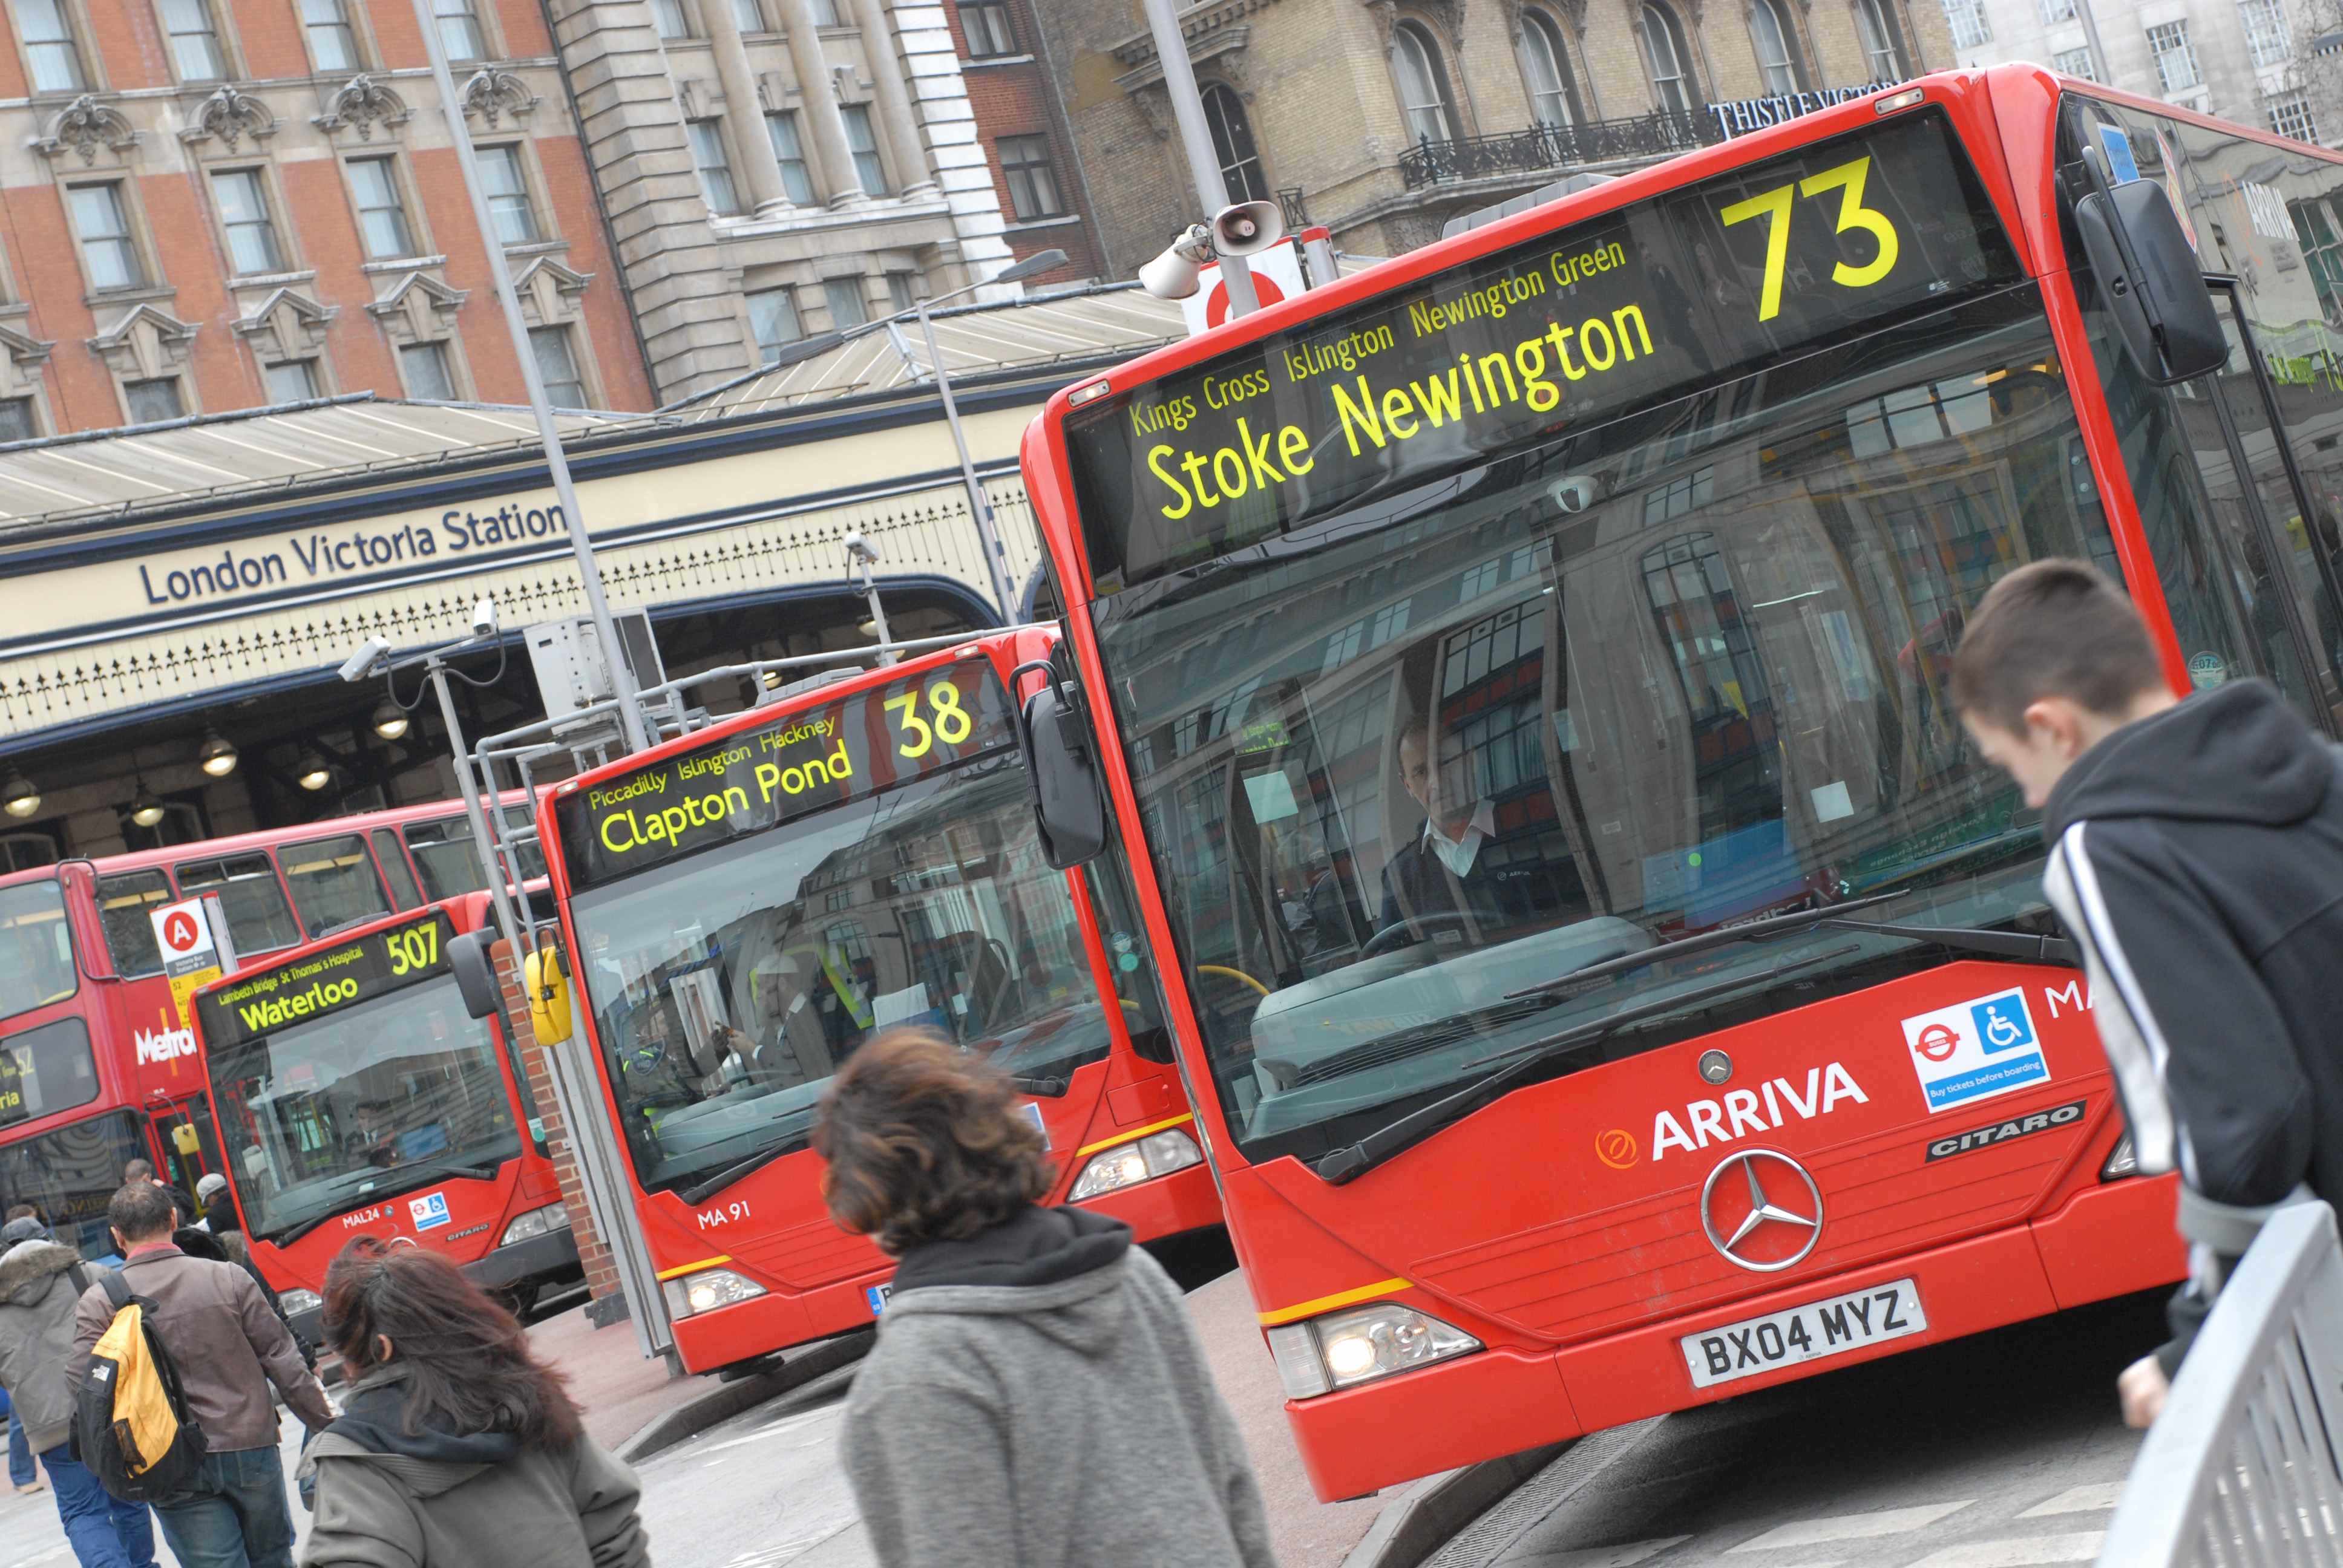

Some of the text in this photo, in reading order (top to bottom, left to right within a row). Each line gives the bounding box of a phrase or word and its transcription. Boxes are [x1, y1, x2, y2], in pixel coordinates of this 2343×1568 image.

[1708, 78, 1912, 141] THISTLE VICT
[1720, 155, 1899, 322] 73
[1130, 242, 1626, 437] Kings Cross Islington Newington Green
[1147, 304, 1654, 520] Stoke Newington
[139, 503, 568, 606] London Victoria Station
[883, 682, 972, 758] 38
[589, 716, 835, 810] Piccadilly Islington Hackney
[600, 737, 853, 853] Clapton Pond
[173, 919, 192, 944] A
[387, 921, 437, 975] 507
[218, 985, 254, 1007] Lambeth
[252, 975, 279, 994] Bridge
[280, 971, 290, 984] St
[239, 978, 358, 1032] Waterloo
[1652, 1062, 1870, 1161] ARRIVA
[1930, 1061, 2041, 1099] Buy tickets before boarding
[1931, 1106, 2080, 1156] CITARO
[342, 1207, 380, 1229] MAL24
[447, 1224, 489, 1241] CITARO
[697, 1200, 751, 1230] MA 91
[1700, 1289, 1909, 1376] BX04 MYZ
